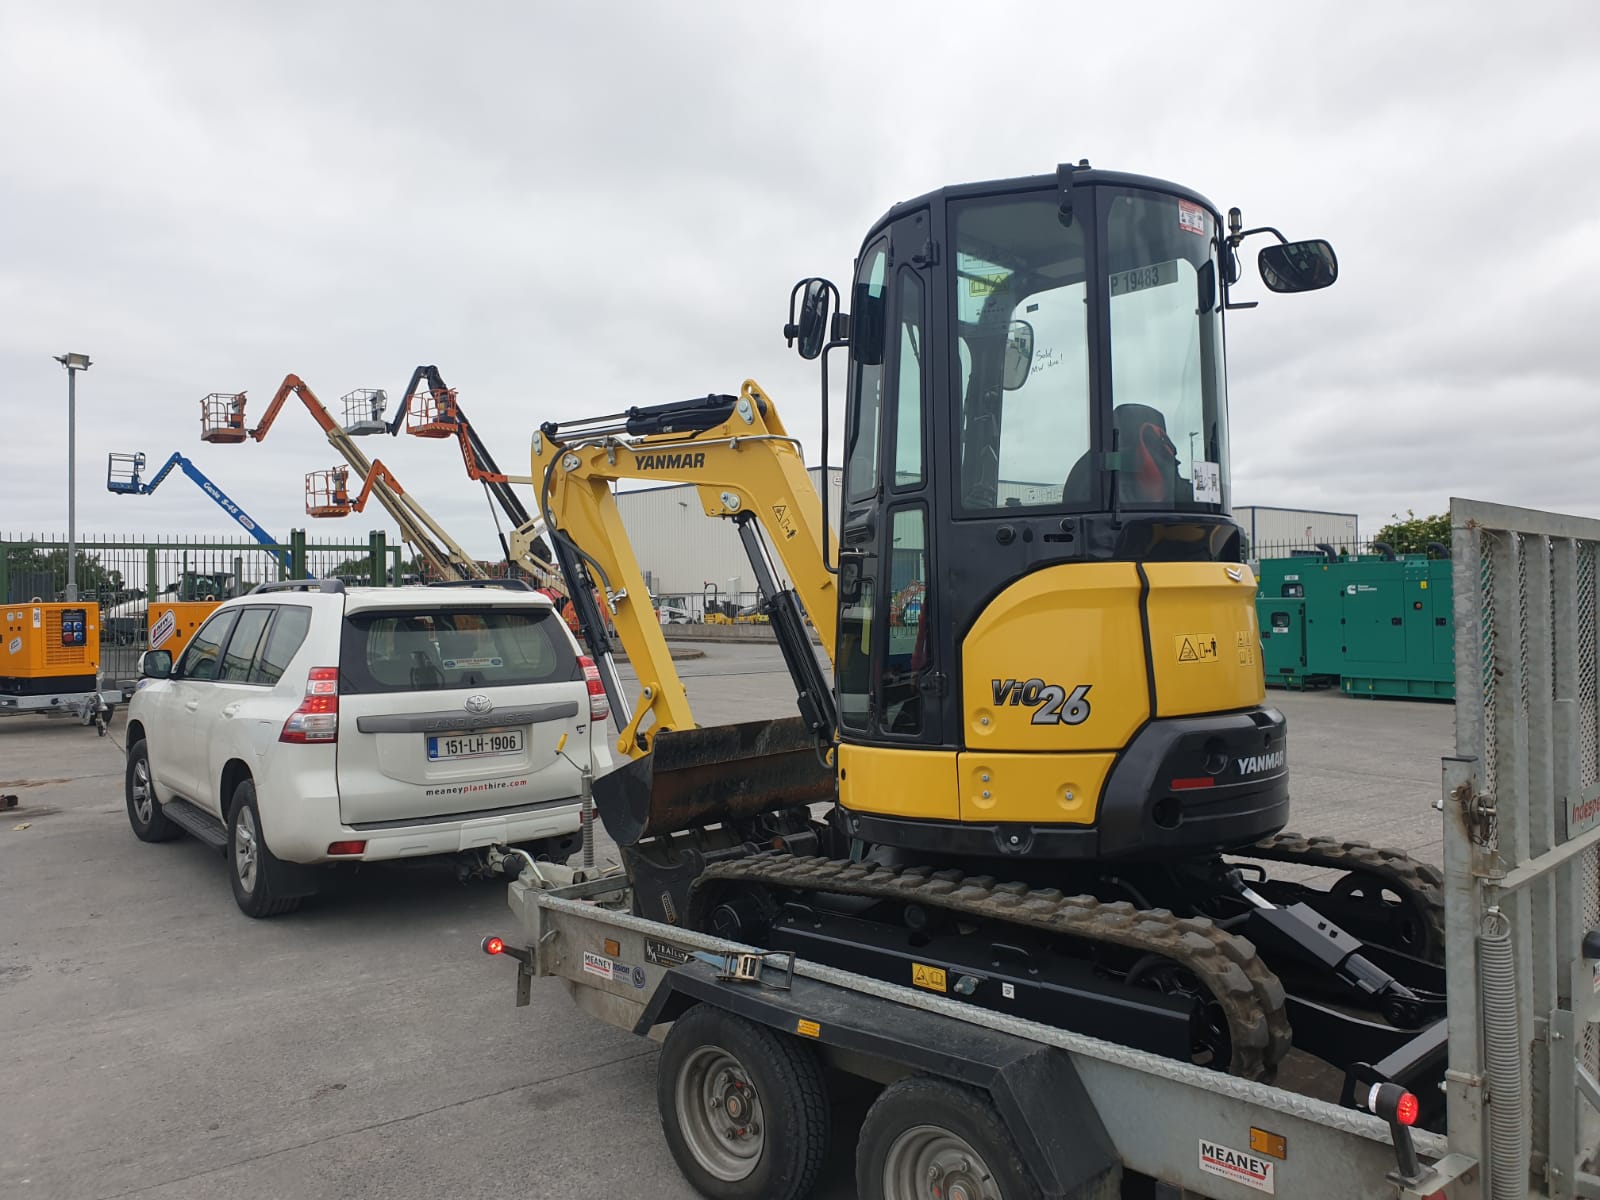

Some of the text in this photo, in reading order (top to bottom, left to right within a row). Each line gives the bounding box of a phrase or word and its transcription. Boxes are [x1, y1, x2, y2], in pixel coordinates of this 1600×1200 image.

[1123, 266, 1160, 292] 19483
[635, 453, 705, 471] YANMAR
[445, 735, 517, 755] 151-LH-1906
[1237, 750, 1285, 775] YANMAR
[425, 779, 528, 796] meaneyplanthire.com
[584, 953, 612, 969] MEANEY
[1201, 1143, 1270, 1177] MEANEY
